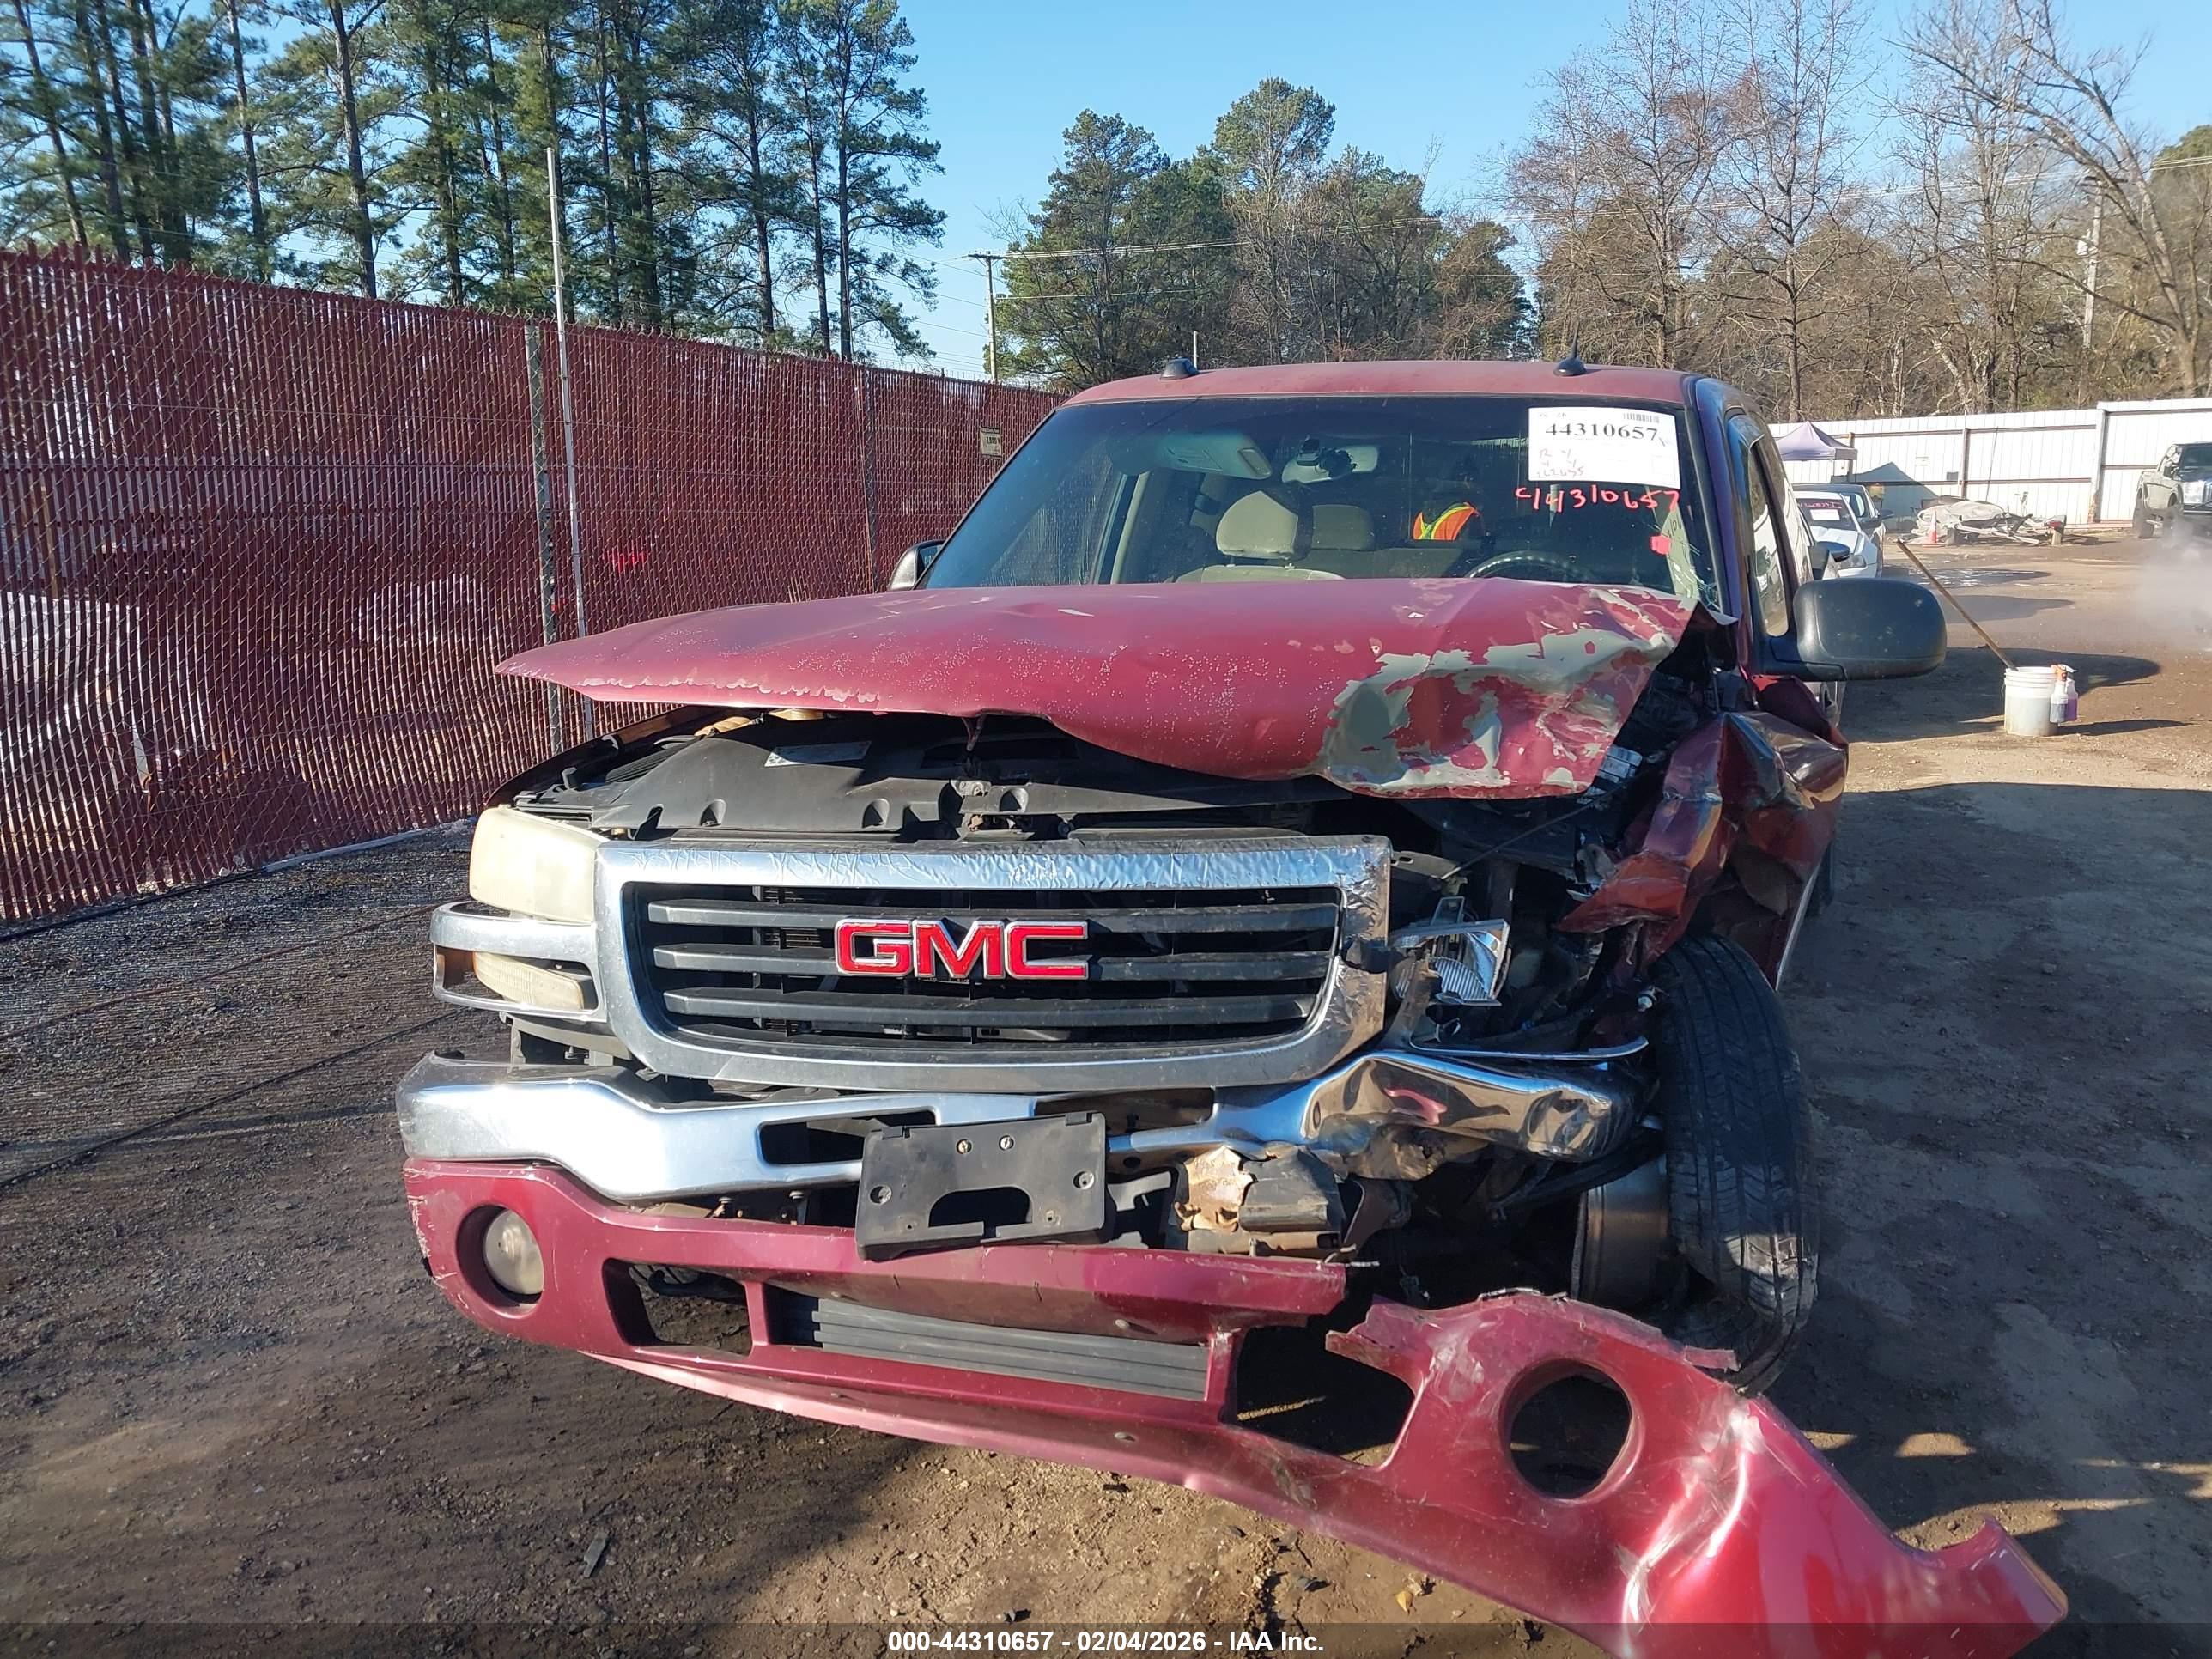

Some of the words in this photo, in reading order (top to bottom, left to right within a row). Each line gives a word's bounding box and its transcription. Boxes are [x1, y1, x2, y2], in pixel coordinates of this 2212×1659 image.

[1546, 422, 1658, 441] 44310657
[1516, 484, 1679, 513] 44310657
[834, 918, 1089, 980] GMC
